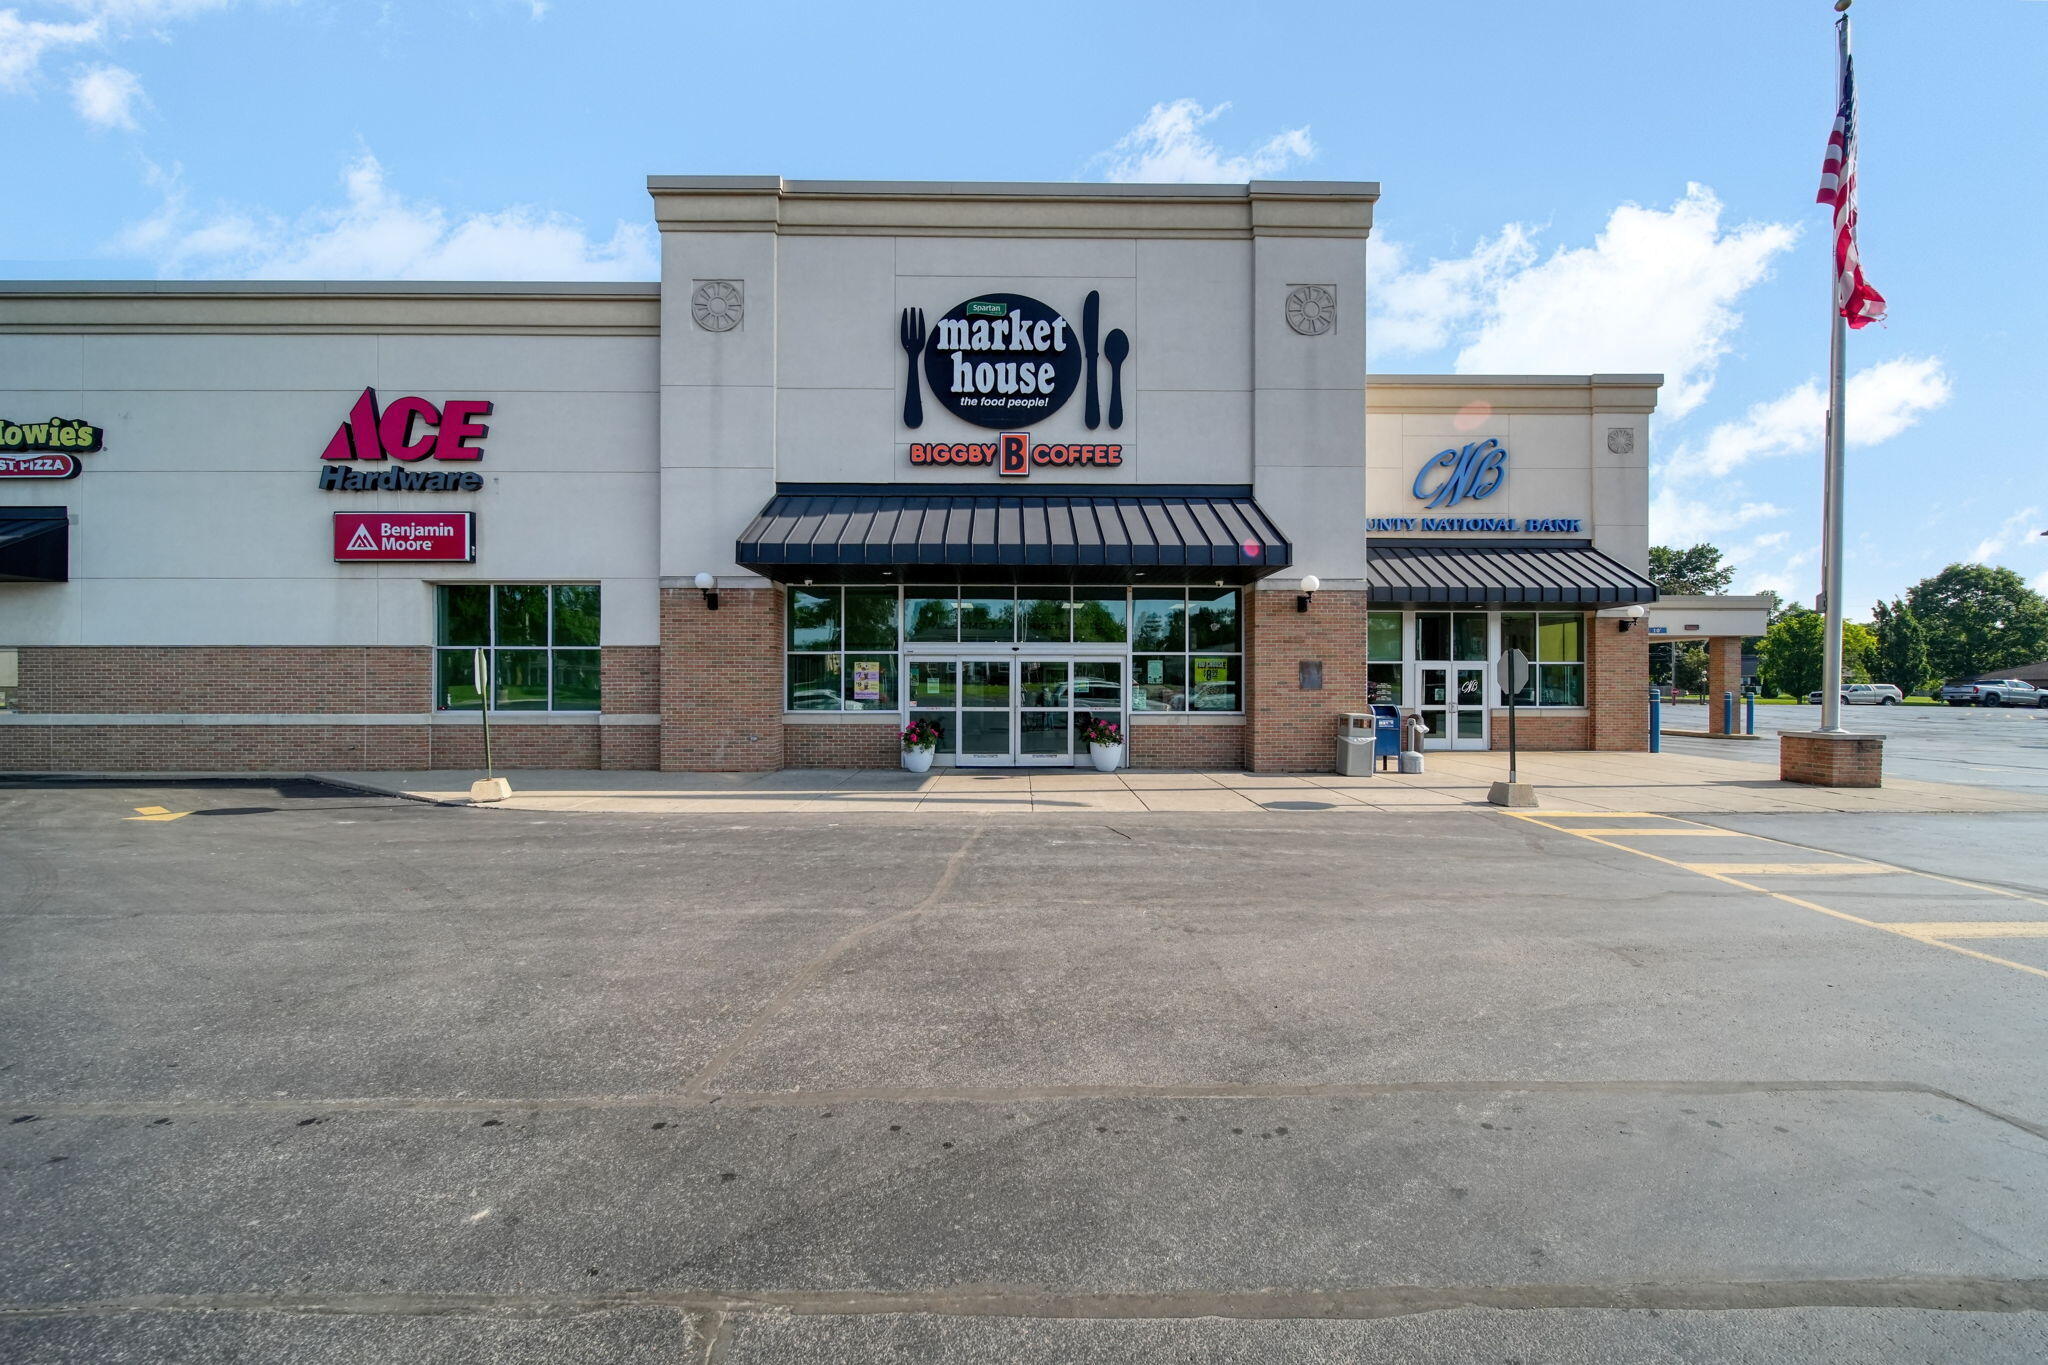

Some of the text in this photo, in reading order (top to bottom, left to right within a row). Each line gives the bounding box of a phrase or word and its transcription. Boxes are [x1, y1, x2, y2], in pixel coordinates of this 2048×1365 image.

[973, 304, 1001, 312] Spartan
[937, 309, 1067, 352] market
[950, 351, 1056, 395] house
[960, 396, 1049, 409] the food people!
[0, 418, 93, 447] owie's
[320, 386, 494, 462] ACE
[20, 459, 65, 471] PIZZA
[910, 437, 1123, 471] BIGGBY B COFFEE
[319, 465, 485, 492] Hardware
[1412, 438, 1508, 509] CNB
[380, 522, 455, 540] Benjamin
[1365, 517, 1584, 533] UNTY NATIONAL BANK
[381, 537, 433, 551] Moore
